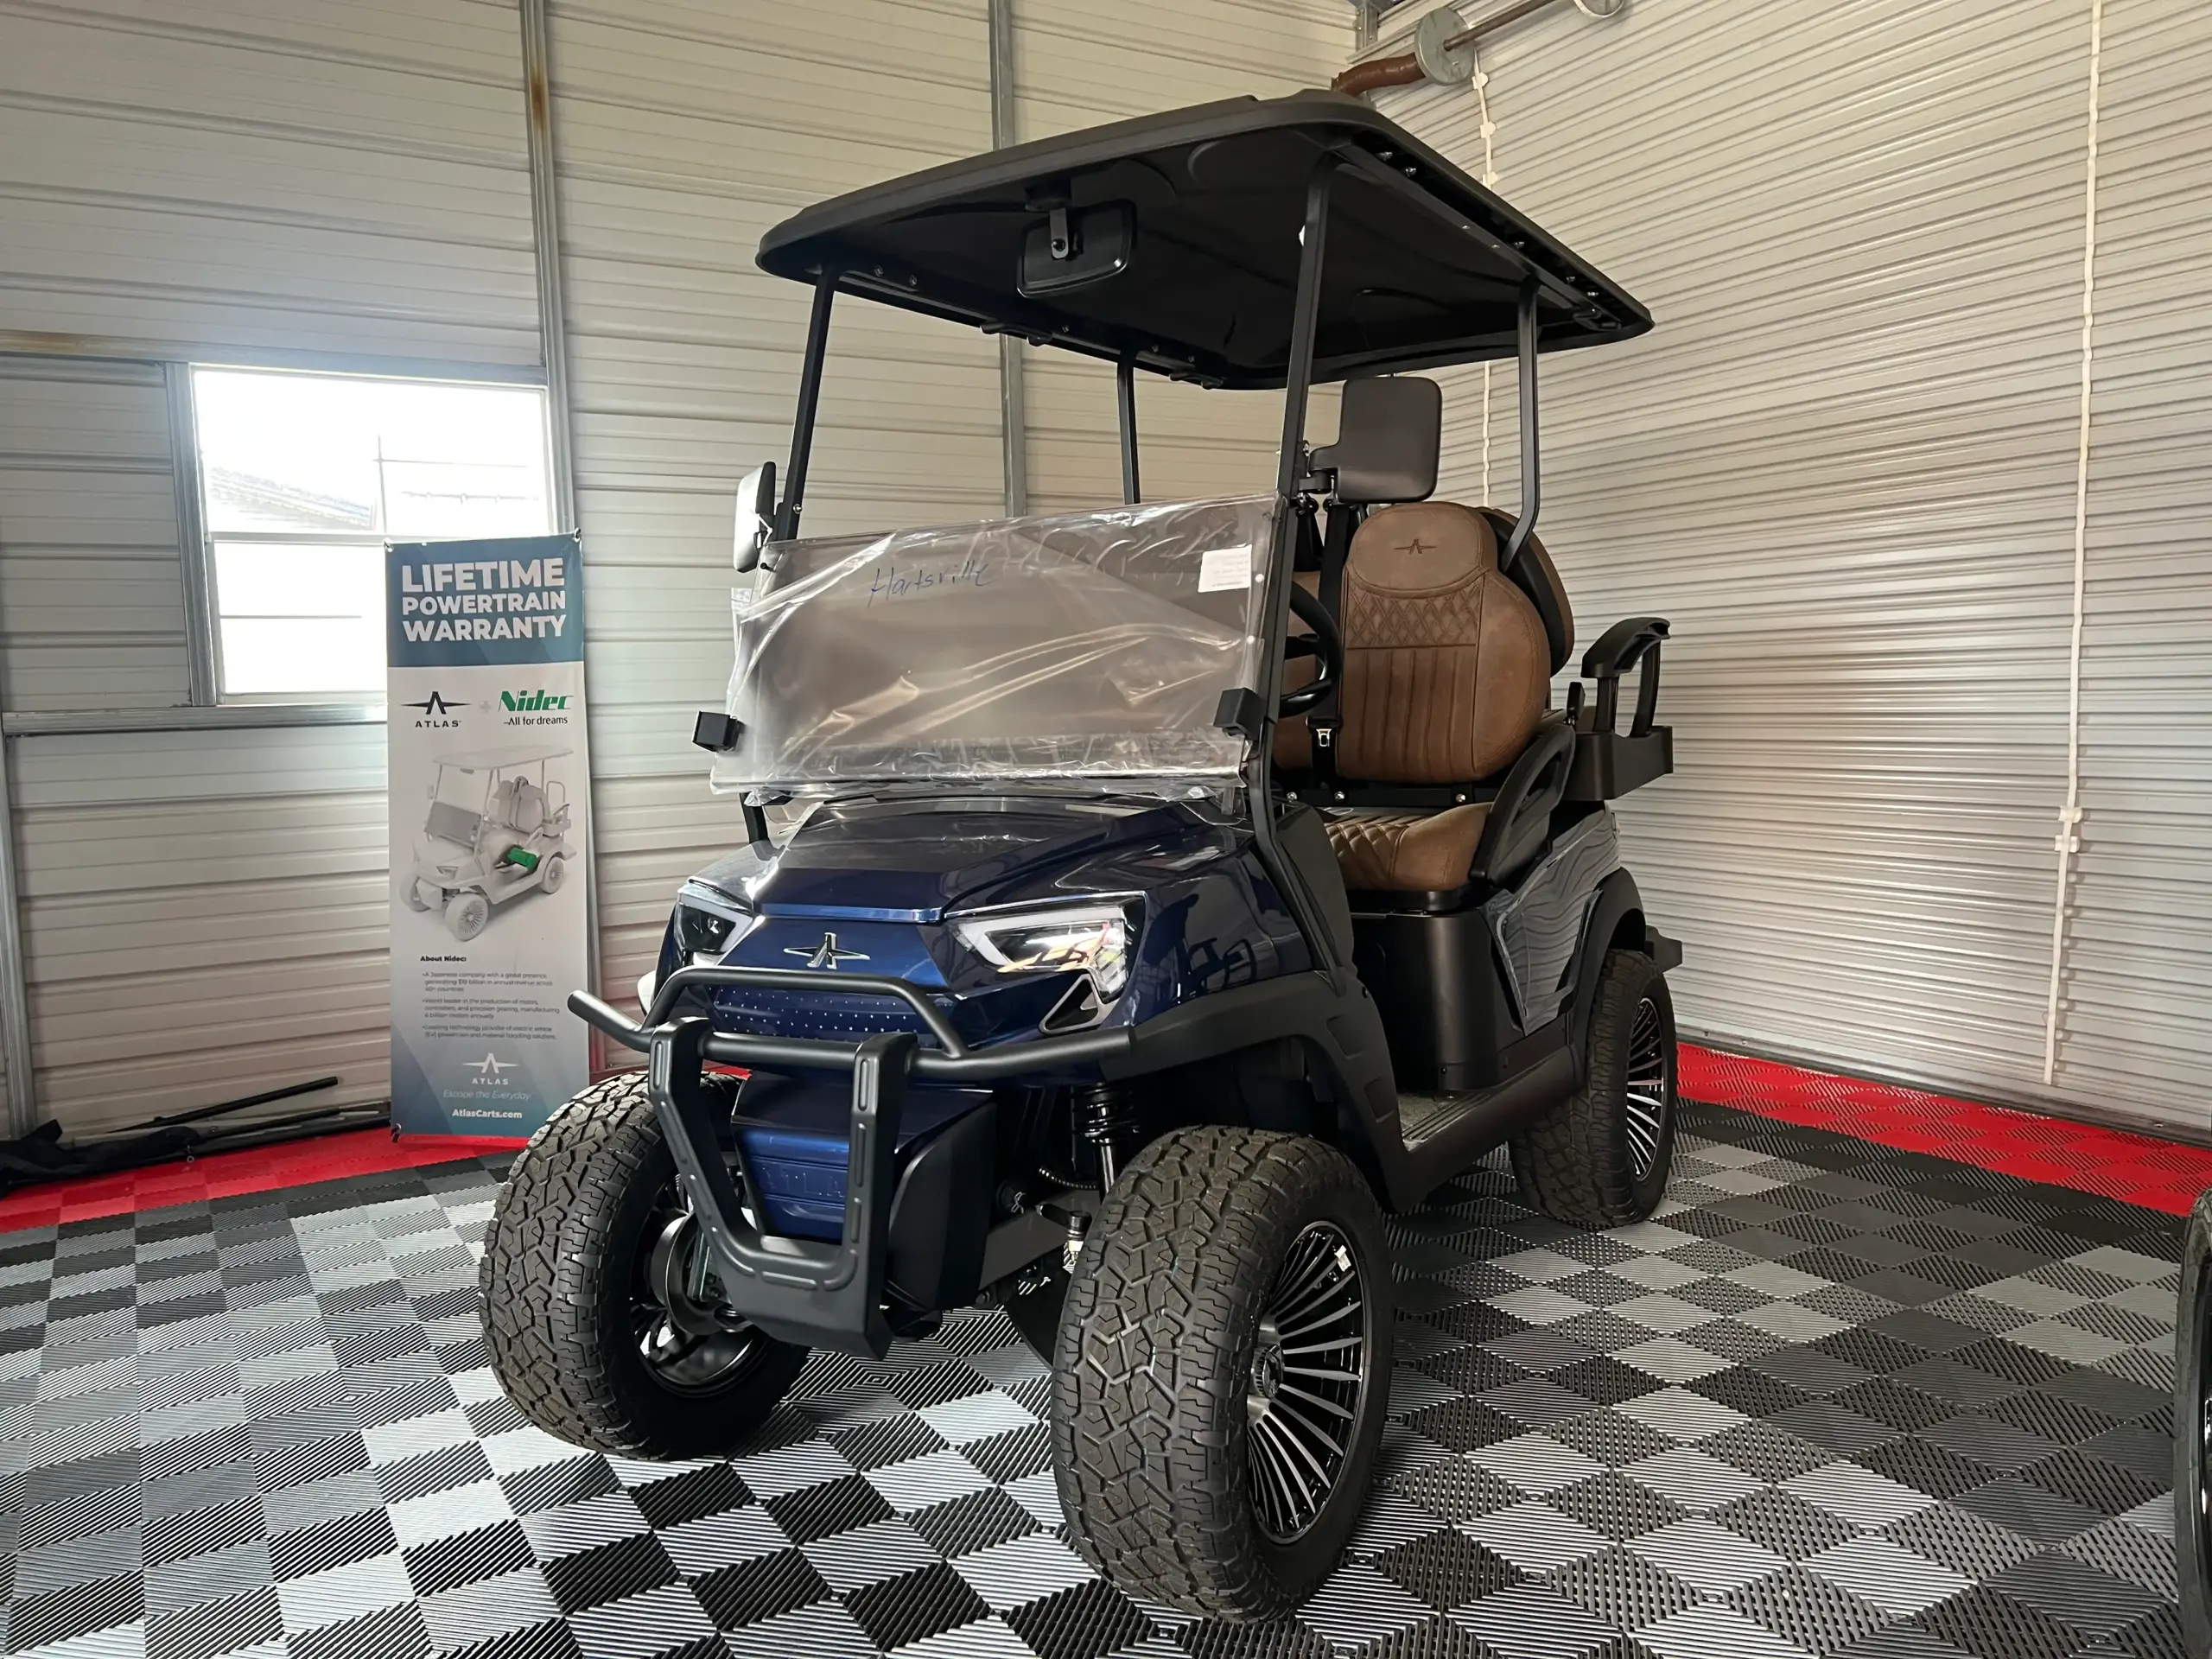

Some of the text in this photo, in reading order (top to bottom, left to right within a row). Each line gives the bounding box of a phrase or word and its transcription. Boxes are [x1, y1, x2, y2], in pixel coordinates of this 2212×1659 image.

[402, 557, 565, 593] LIFETIME
[402, 590, 566, 616] POWERTRAIN
[402, 614, 567, 642] WARRANTY
[498, 689, 574, 712] Nidec
[415, 720, 460, 728] ATLAS
[523, 716, 534, 725] for
[537, 716, 568, 725] dreams
[442, 1089, 532, 1102] Escape the Everyday
[452, 1109, 523, 1119] AtlasCarts.com
